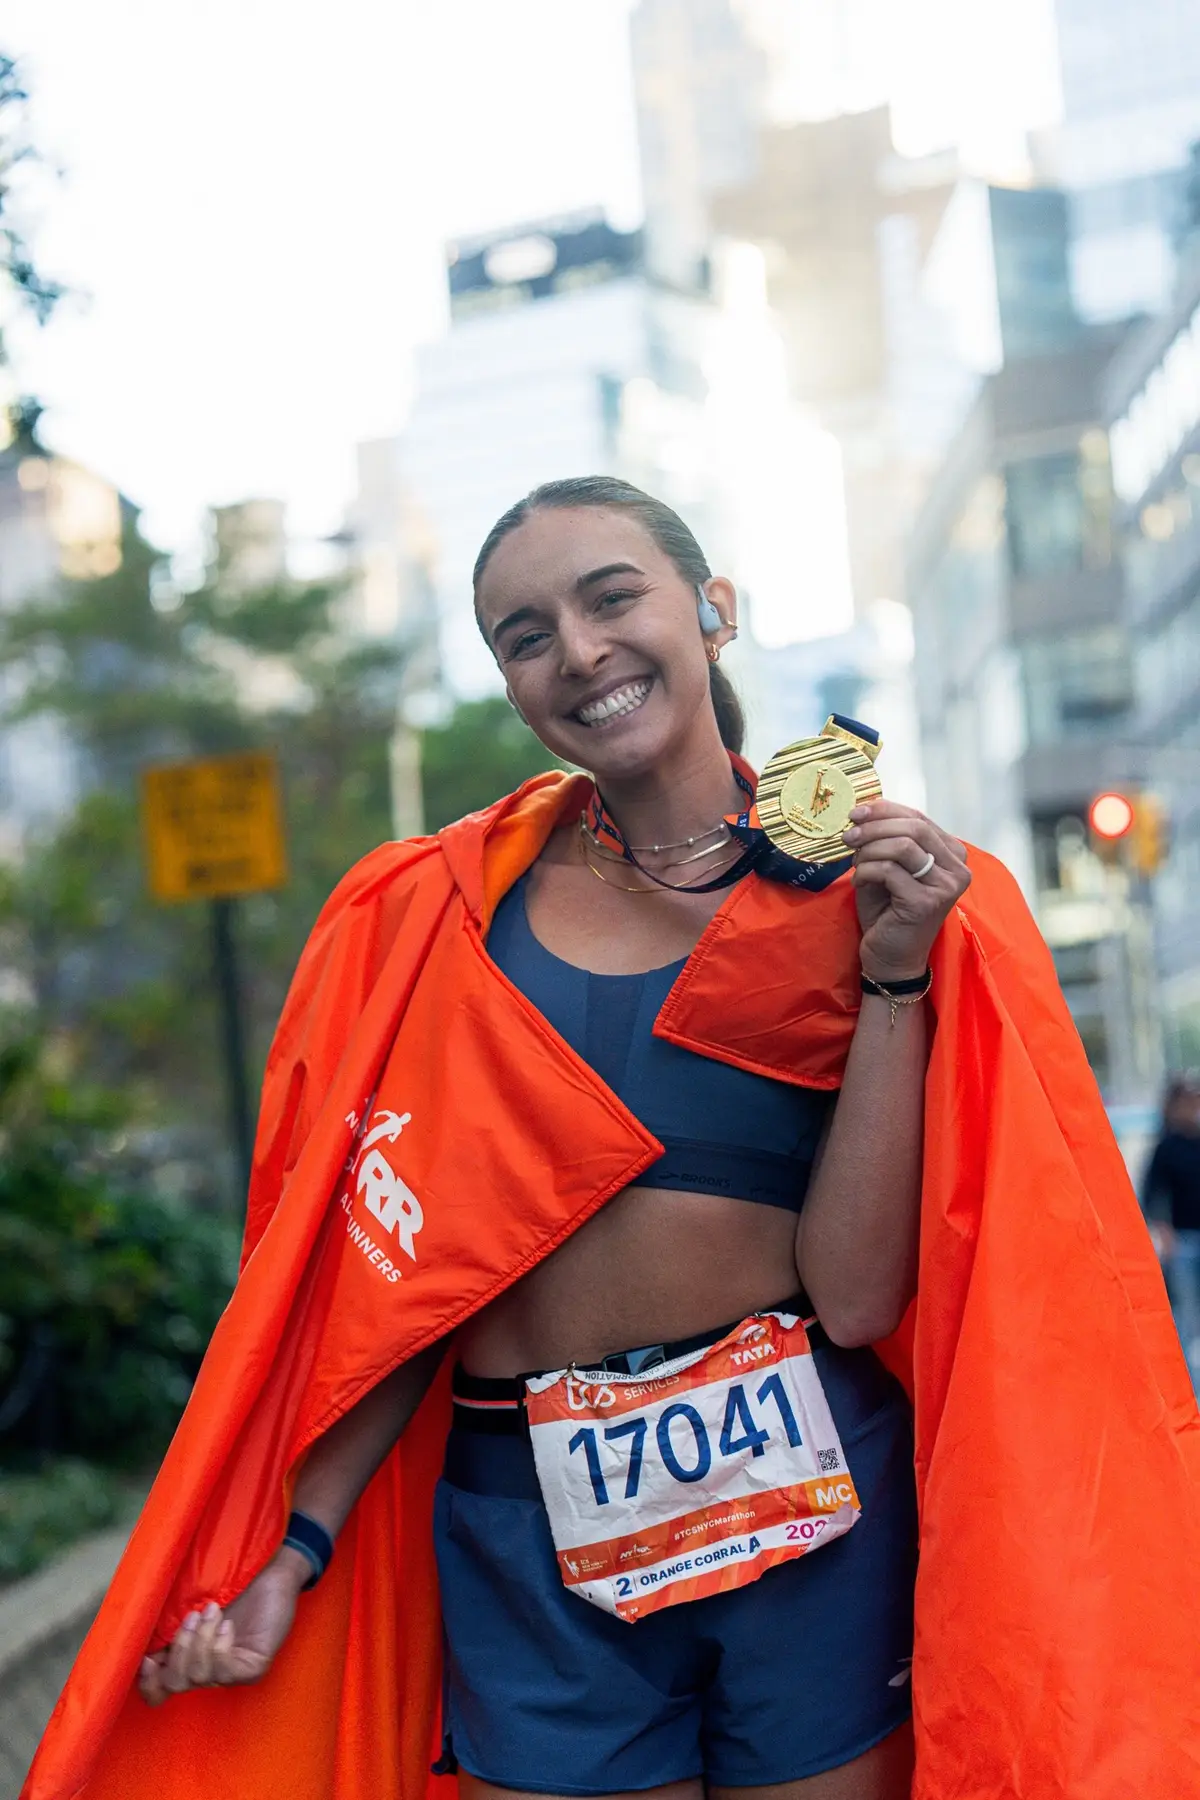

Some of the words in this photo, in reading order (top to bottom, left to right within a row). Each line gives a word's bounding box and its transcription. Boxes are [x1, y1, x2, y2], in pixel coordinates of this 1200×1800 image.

[681, 1173, 732, 1189] BROOKS
[730, 1343, 776, 1366] TATA
[623, 1374, 680, 1401] SERVICES
[568, 1372, 803, 1506] 17041
[815, 1483, 853, 1508] MC
[674, 1510, 756, 1541] #TCSNYCMarathon
[640, 1560, 693, 1586] ORANGE
[694, 1543, 746, 1567] CORRAL
[748, 1535, 761, 1554] A
